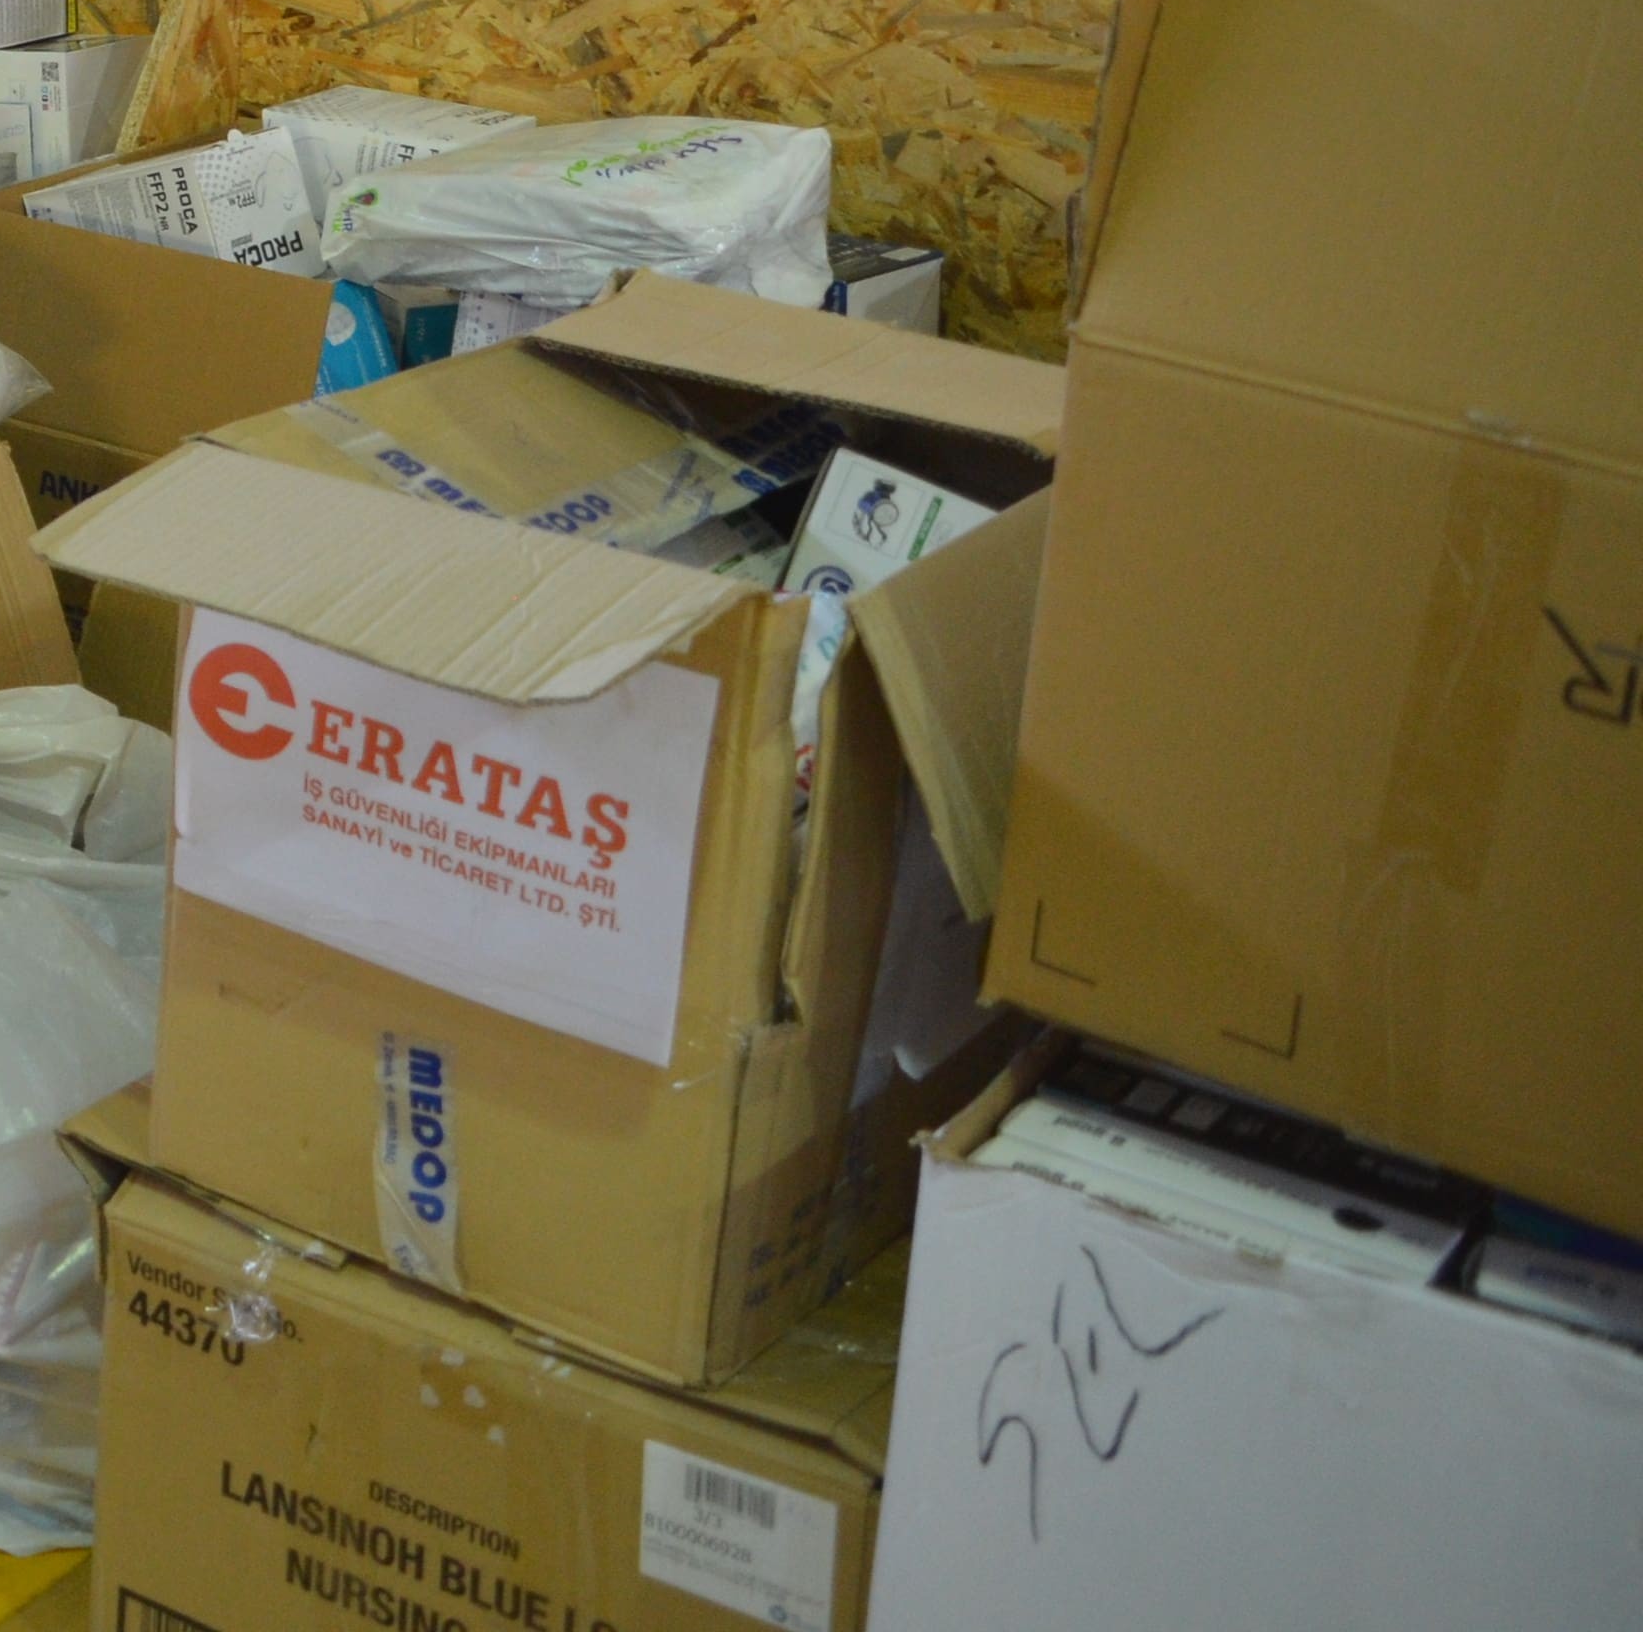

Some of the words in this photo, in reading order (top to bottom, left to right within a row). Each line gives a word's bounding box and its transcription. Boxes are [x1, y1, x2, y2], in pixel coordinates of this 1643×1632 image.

[146, 171, 169, 215] FFP2
[171, 166, 200, 235] PROCA
[235, 190, 257, 210] FFP2
[233, 229, 305, 267] PROCA
[305, 698, 631, 871] ERATAŞ
[301, 803, 384, 849] SANAYİ
[388, 834, 414, 860] ve
[418, 845, 515, 897] TİCARET
[518, 884, 571, 917] LTD.
[577, 901, 622, 935] ŞTİ.
[302, 770, 324, 801] İŞ
[329, 784, 449, 846] GÜVENLİĞİ
[453, 830, 616, 901] EKİPMANLARI
[126, 1250, 206, 1304] Vendor
[220, 1460, 427, 1584] LANSINOH
[439, 1553, 551, 1632] BLUE
[367, 1479, 522, 1563] DESCRIPTION
